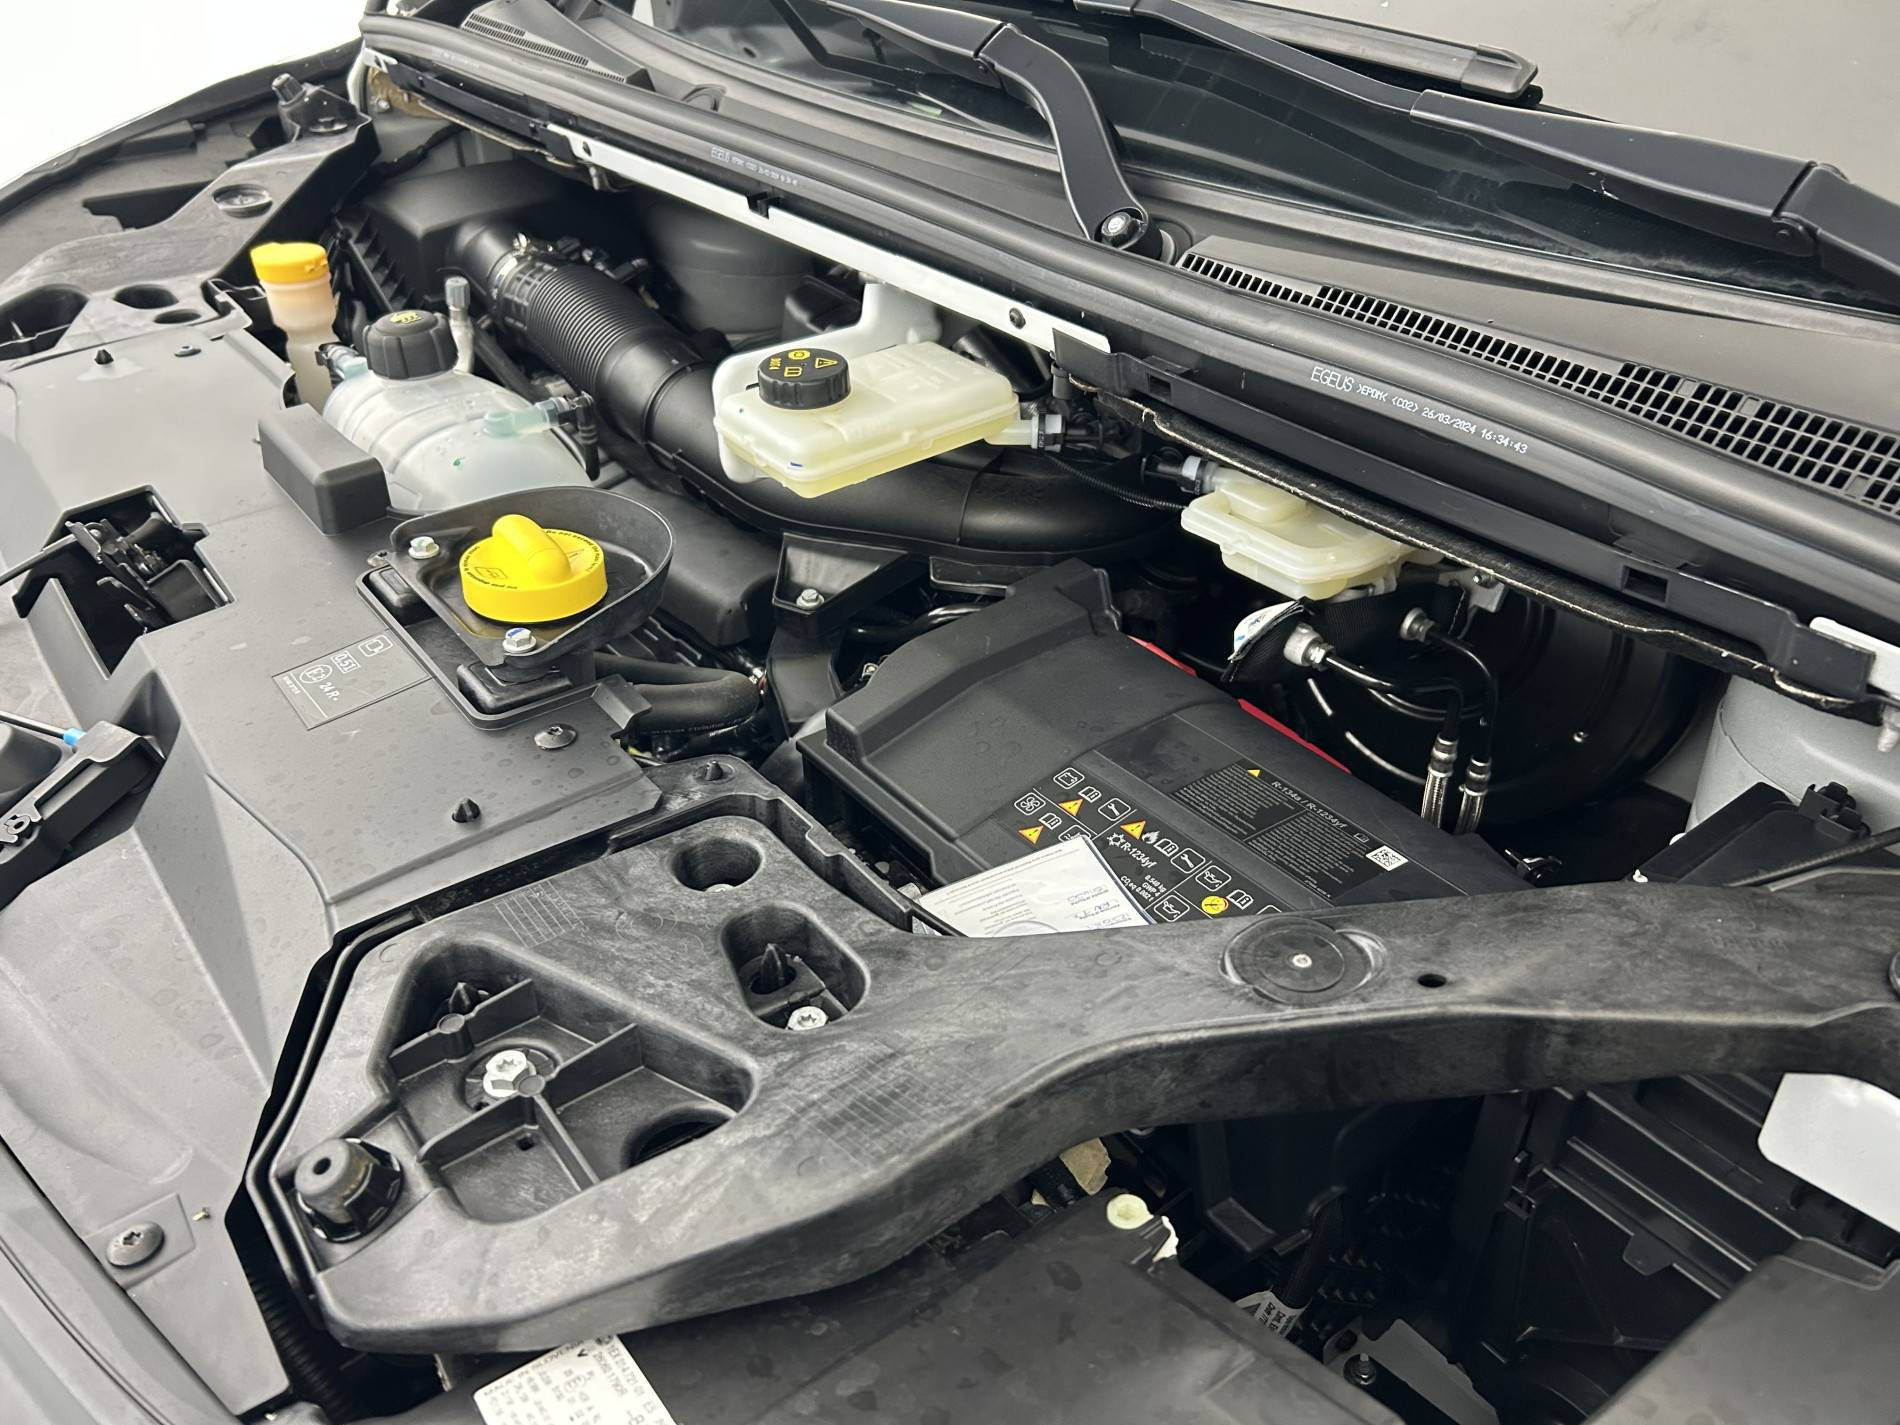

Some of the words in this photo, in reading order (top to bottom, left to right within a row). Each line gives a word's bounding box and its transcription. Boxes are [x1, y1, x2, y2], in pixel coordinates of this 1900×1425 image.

[1311, 366, 1354, 392] EGEUS
[1421, 407, 1477, 435] 26/03/2024
[1480, 428, 1528, 454] 16:34:43
[1271, 781, 1302, 801] R-134a
[1306, 802, 1348, 828] R-1234yf
[1120, 841, 1157, 868] R-1234yf
[1141, 882, 1157, 893] GWP
